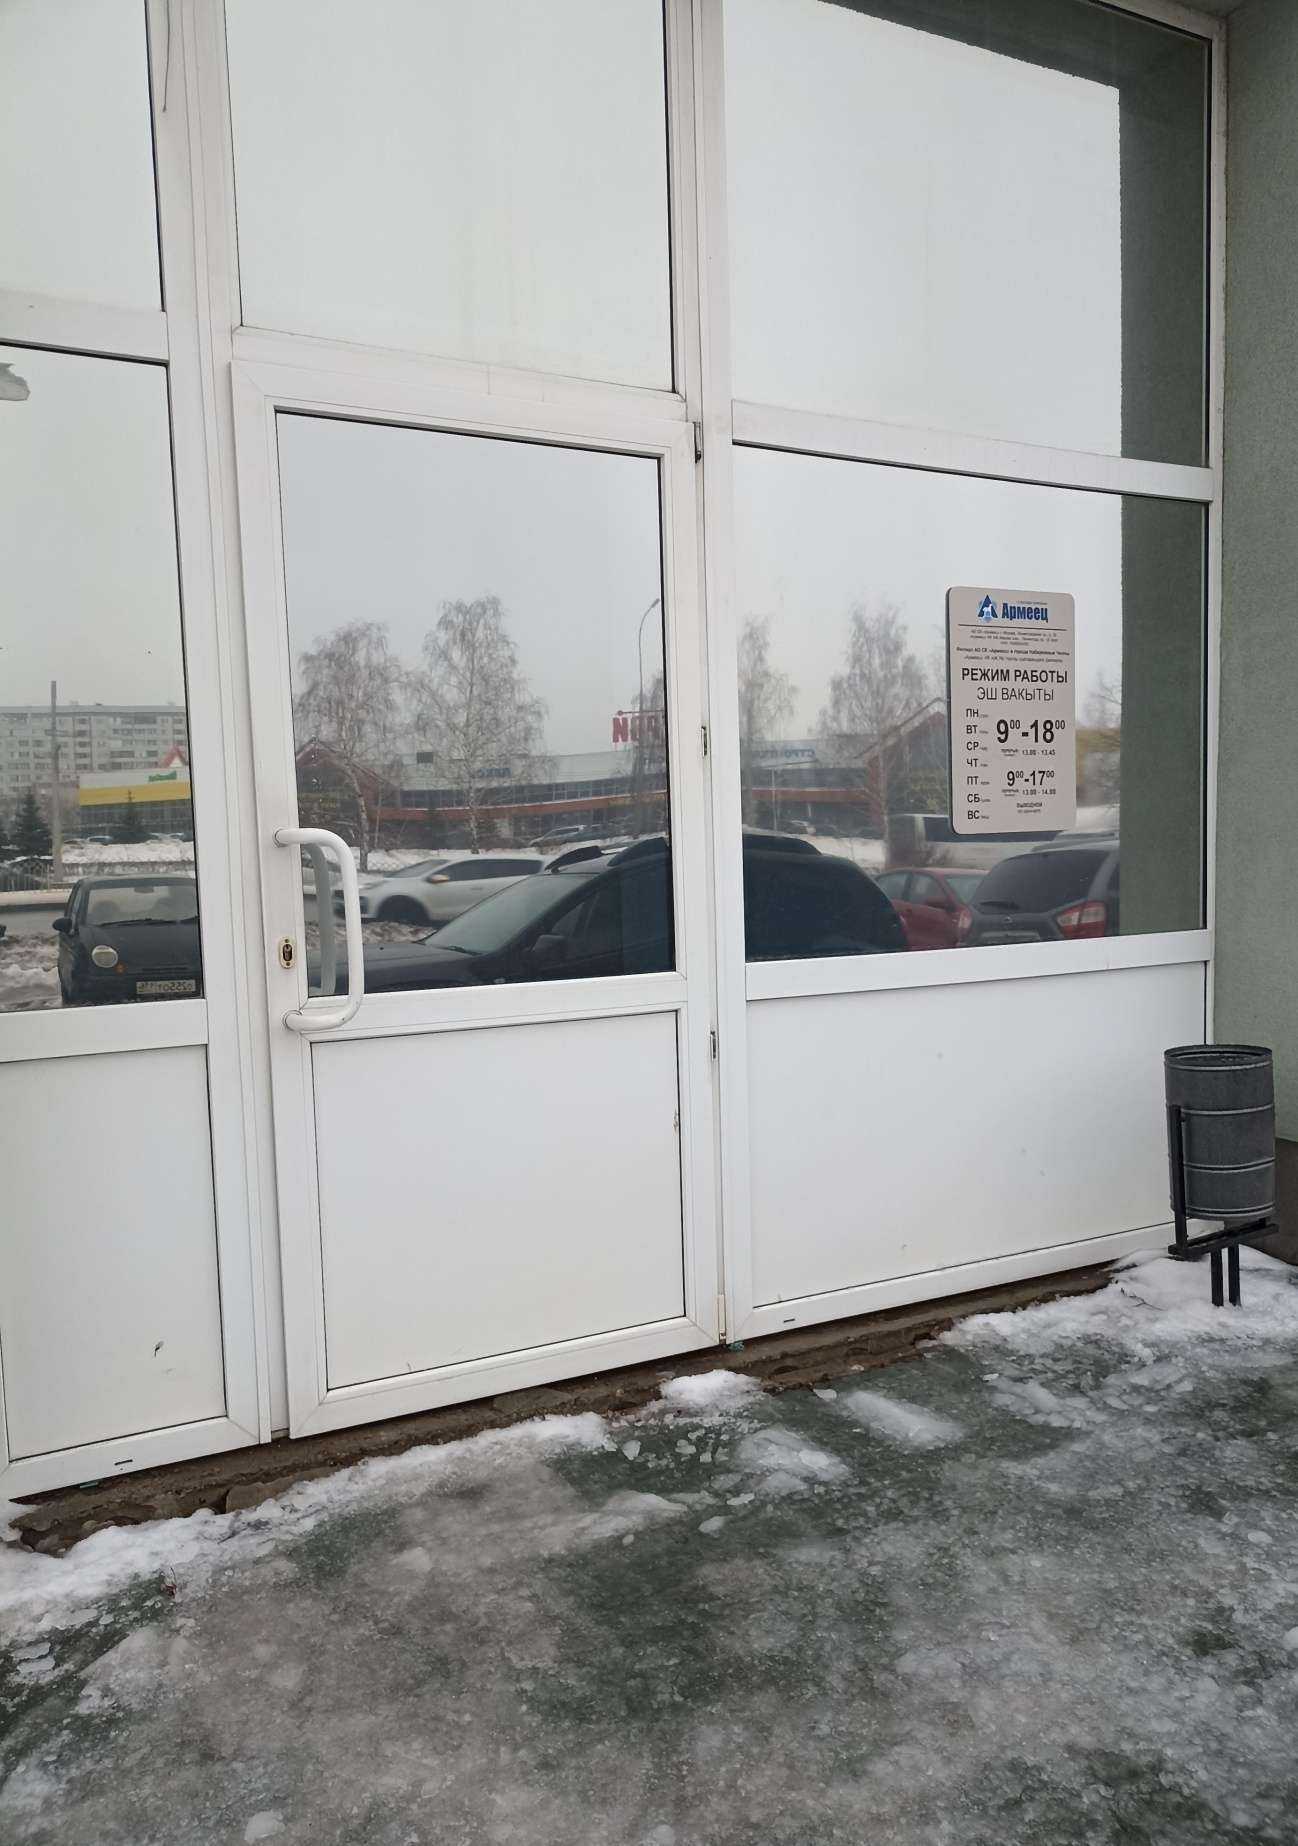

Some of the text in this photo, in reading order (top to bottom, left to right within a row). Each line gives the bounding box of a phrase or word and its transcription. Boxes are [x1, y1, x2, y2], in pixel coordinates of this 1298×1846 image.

[1001, 602, 1049, 623] Армеец
[961, 667, 1068, 684] РЕЖИМ РАБОТЫ
[977, 687, 1054, 701] ЭШ ВАКЫТЫ
[966, 708, 979, 718] ПН
[966, 725, 978, 734] ВТ
[966, 741, 979, 751] СР
[966, 758, 978, 767] ЧТ
[966, 776, 979, 785] ПТ
[967, 793, 980, 803] СБ
[967, 810, 980, 820] ВС
